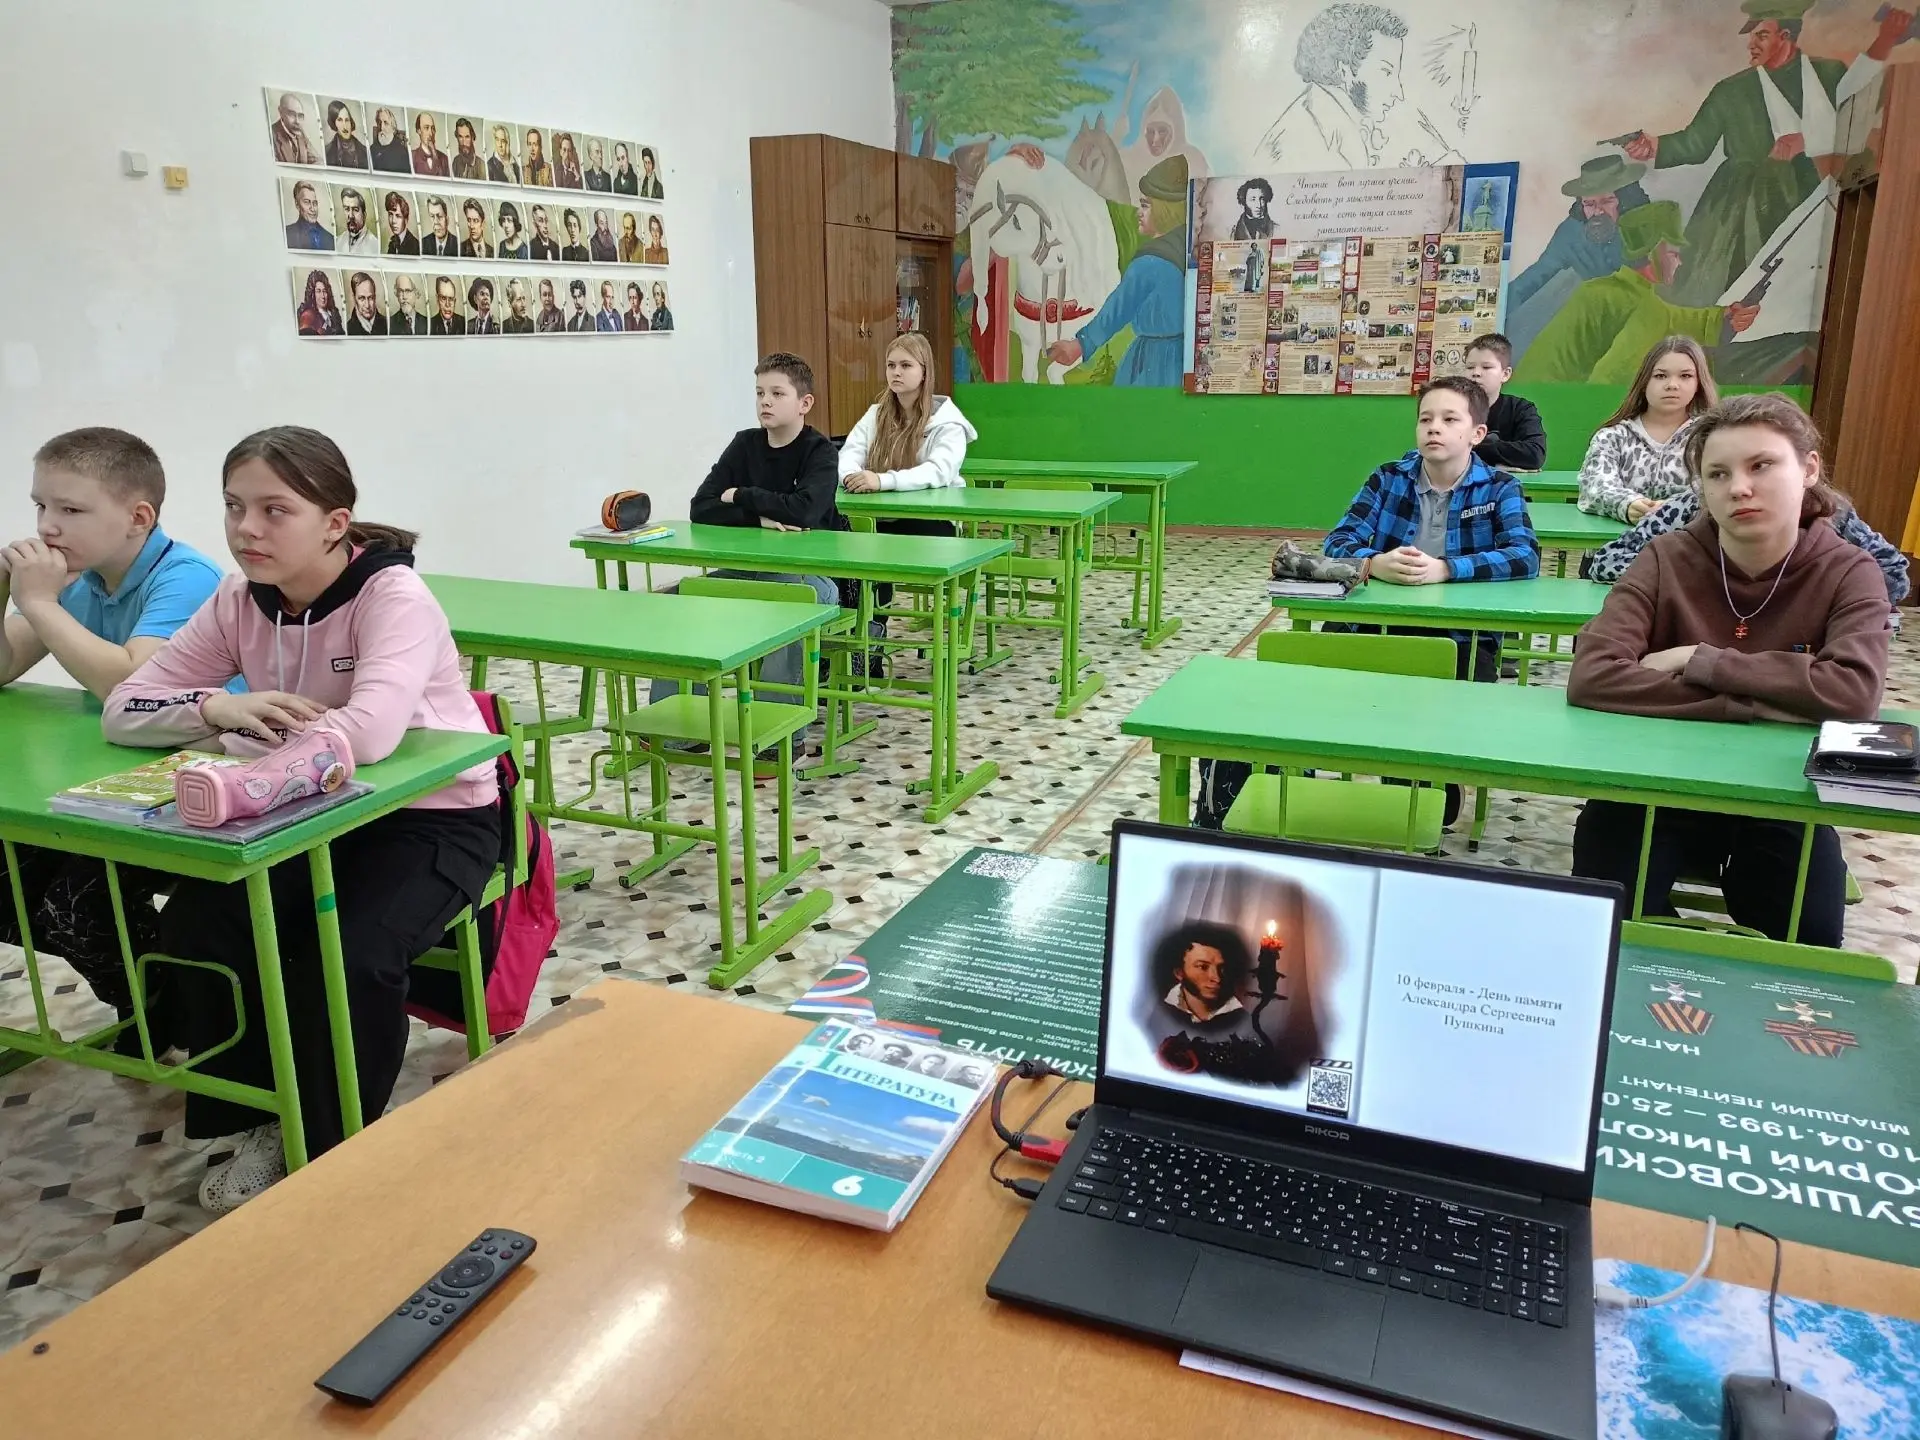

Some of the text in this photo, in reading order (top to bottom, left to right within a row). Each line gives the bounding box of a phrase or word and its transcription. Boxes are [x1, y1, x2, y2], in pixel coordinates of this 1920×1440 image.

[1397, 973, 1411, 986] 10
[1414, 977, 1466, 995] февраля
[1477, 987, 1511, 1002] День
[1515, 995, 1563, 1011] памяти
[1402, 992, 1556, 1027] Александра Сергеевича
[1444, 1014, 1505, 1035] Пушкина
[1042, 1020, 1098, 1035] ильевская
[1610, 1031, 1700, 1056] НАГРА
[1619, 1075, 1910, 1136] МЛАДШИЙ ЛЕЙТЕНАНТ
[1304, 1124, 1350, 1141] RIKOR
[1717, 1112, 1920, 1163] 10.04.1993
[832, 1175, 865, 1197] 6
[1770, 1150, 1920, 1196] Юрий
